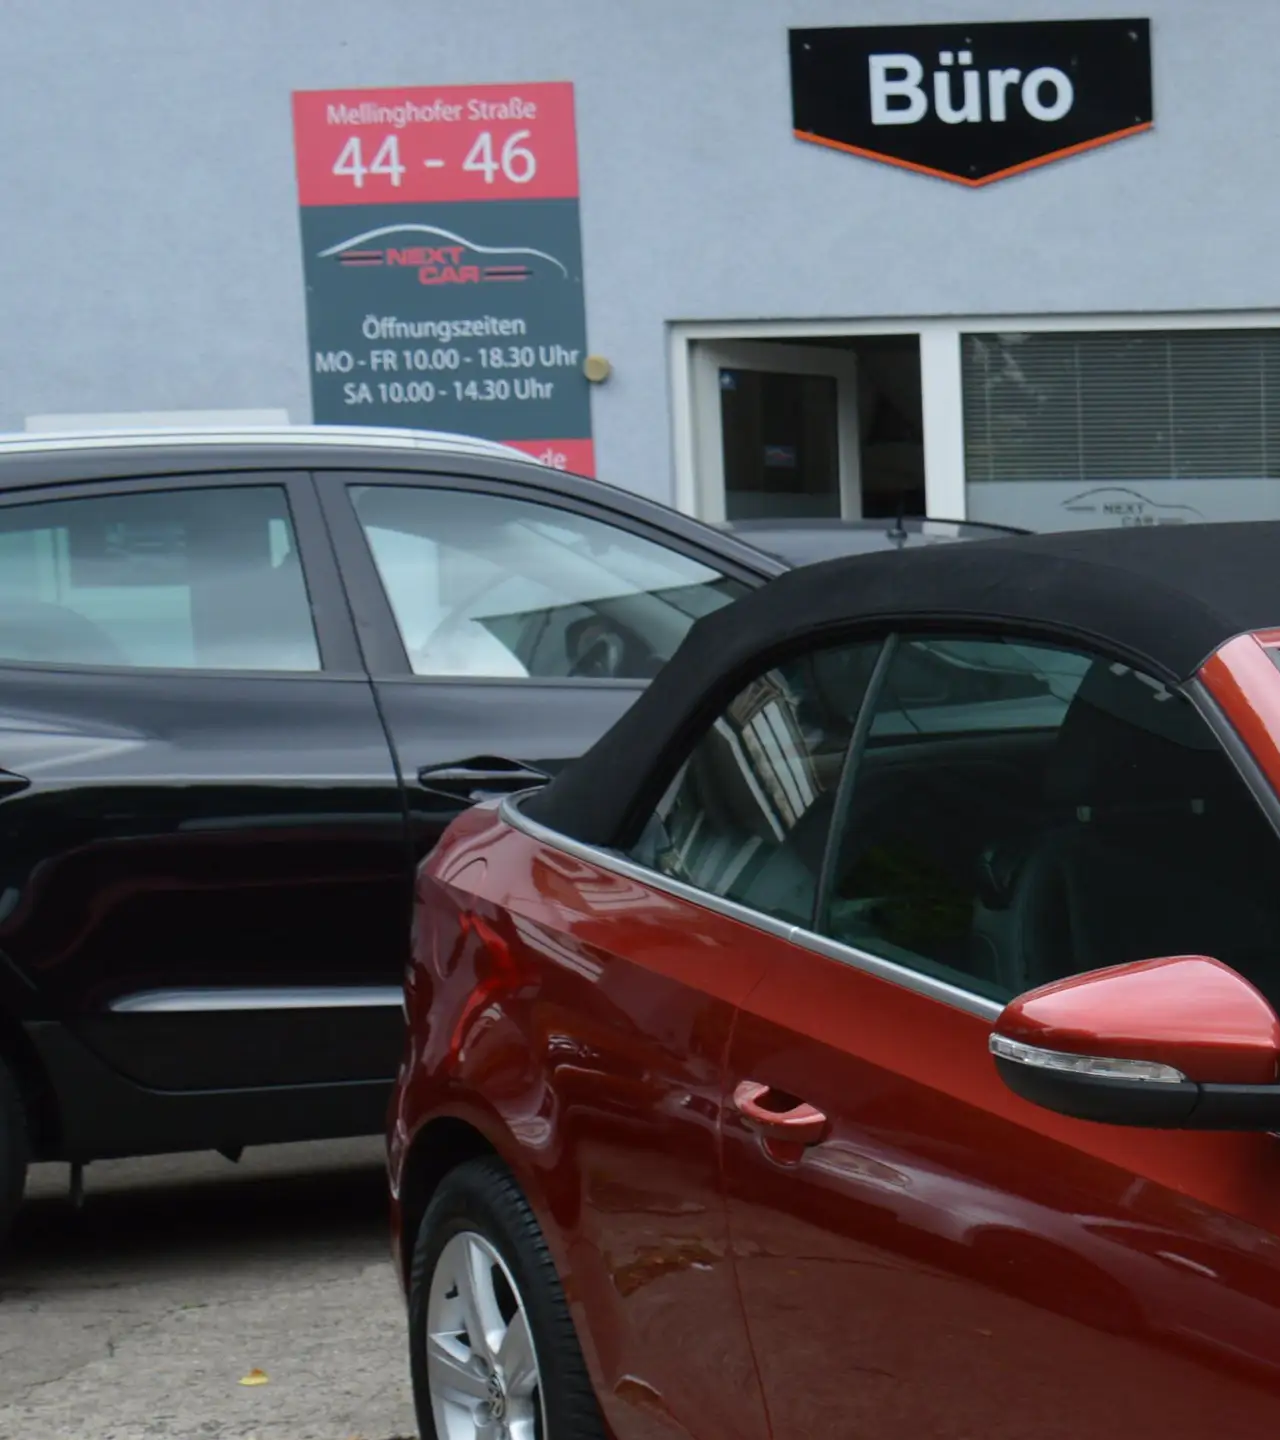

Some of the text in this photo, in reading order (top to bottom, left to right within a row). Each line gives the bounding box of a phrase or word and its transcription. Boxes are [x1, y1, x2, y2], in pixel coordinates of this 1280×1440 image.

[868, 50, 1075, 126] Büro
[327, 97, 537, 128] Mellinghofer Straße
[332, 130, 537, 188] 44 - 46
[386, 247, 465, 266] NEXT
[418, 266, 481, 285] CAR
[362, 314, 526, 342] Öffnungszeiten
[315, 351, 354, 373] MO
[370, 349, 398, 371] FR
[403, 348, 459, 371] 10.00
[479, 346, 535, 369] 18.30
[539, 344, 581, 367] Uhr
[343, 383, 373, 405] SA
[378, 381, 434, 403] 10.00
[453, 379, 509, 401] 14.30
[513, 377, 554, 400] Uhr
[1103, 503, 1146, 515] NEXT
